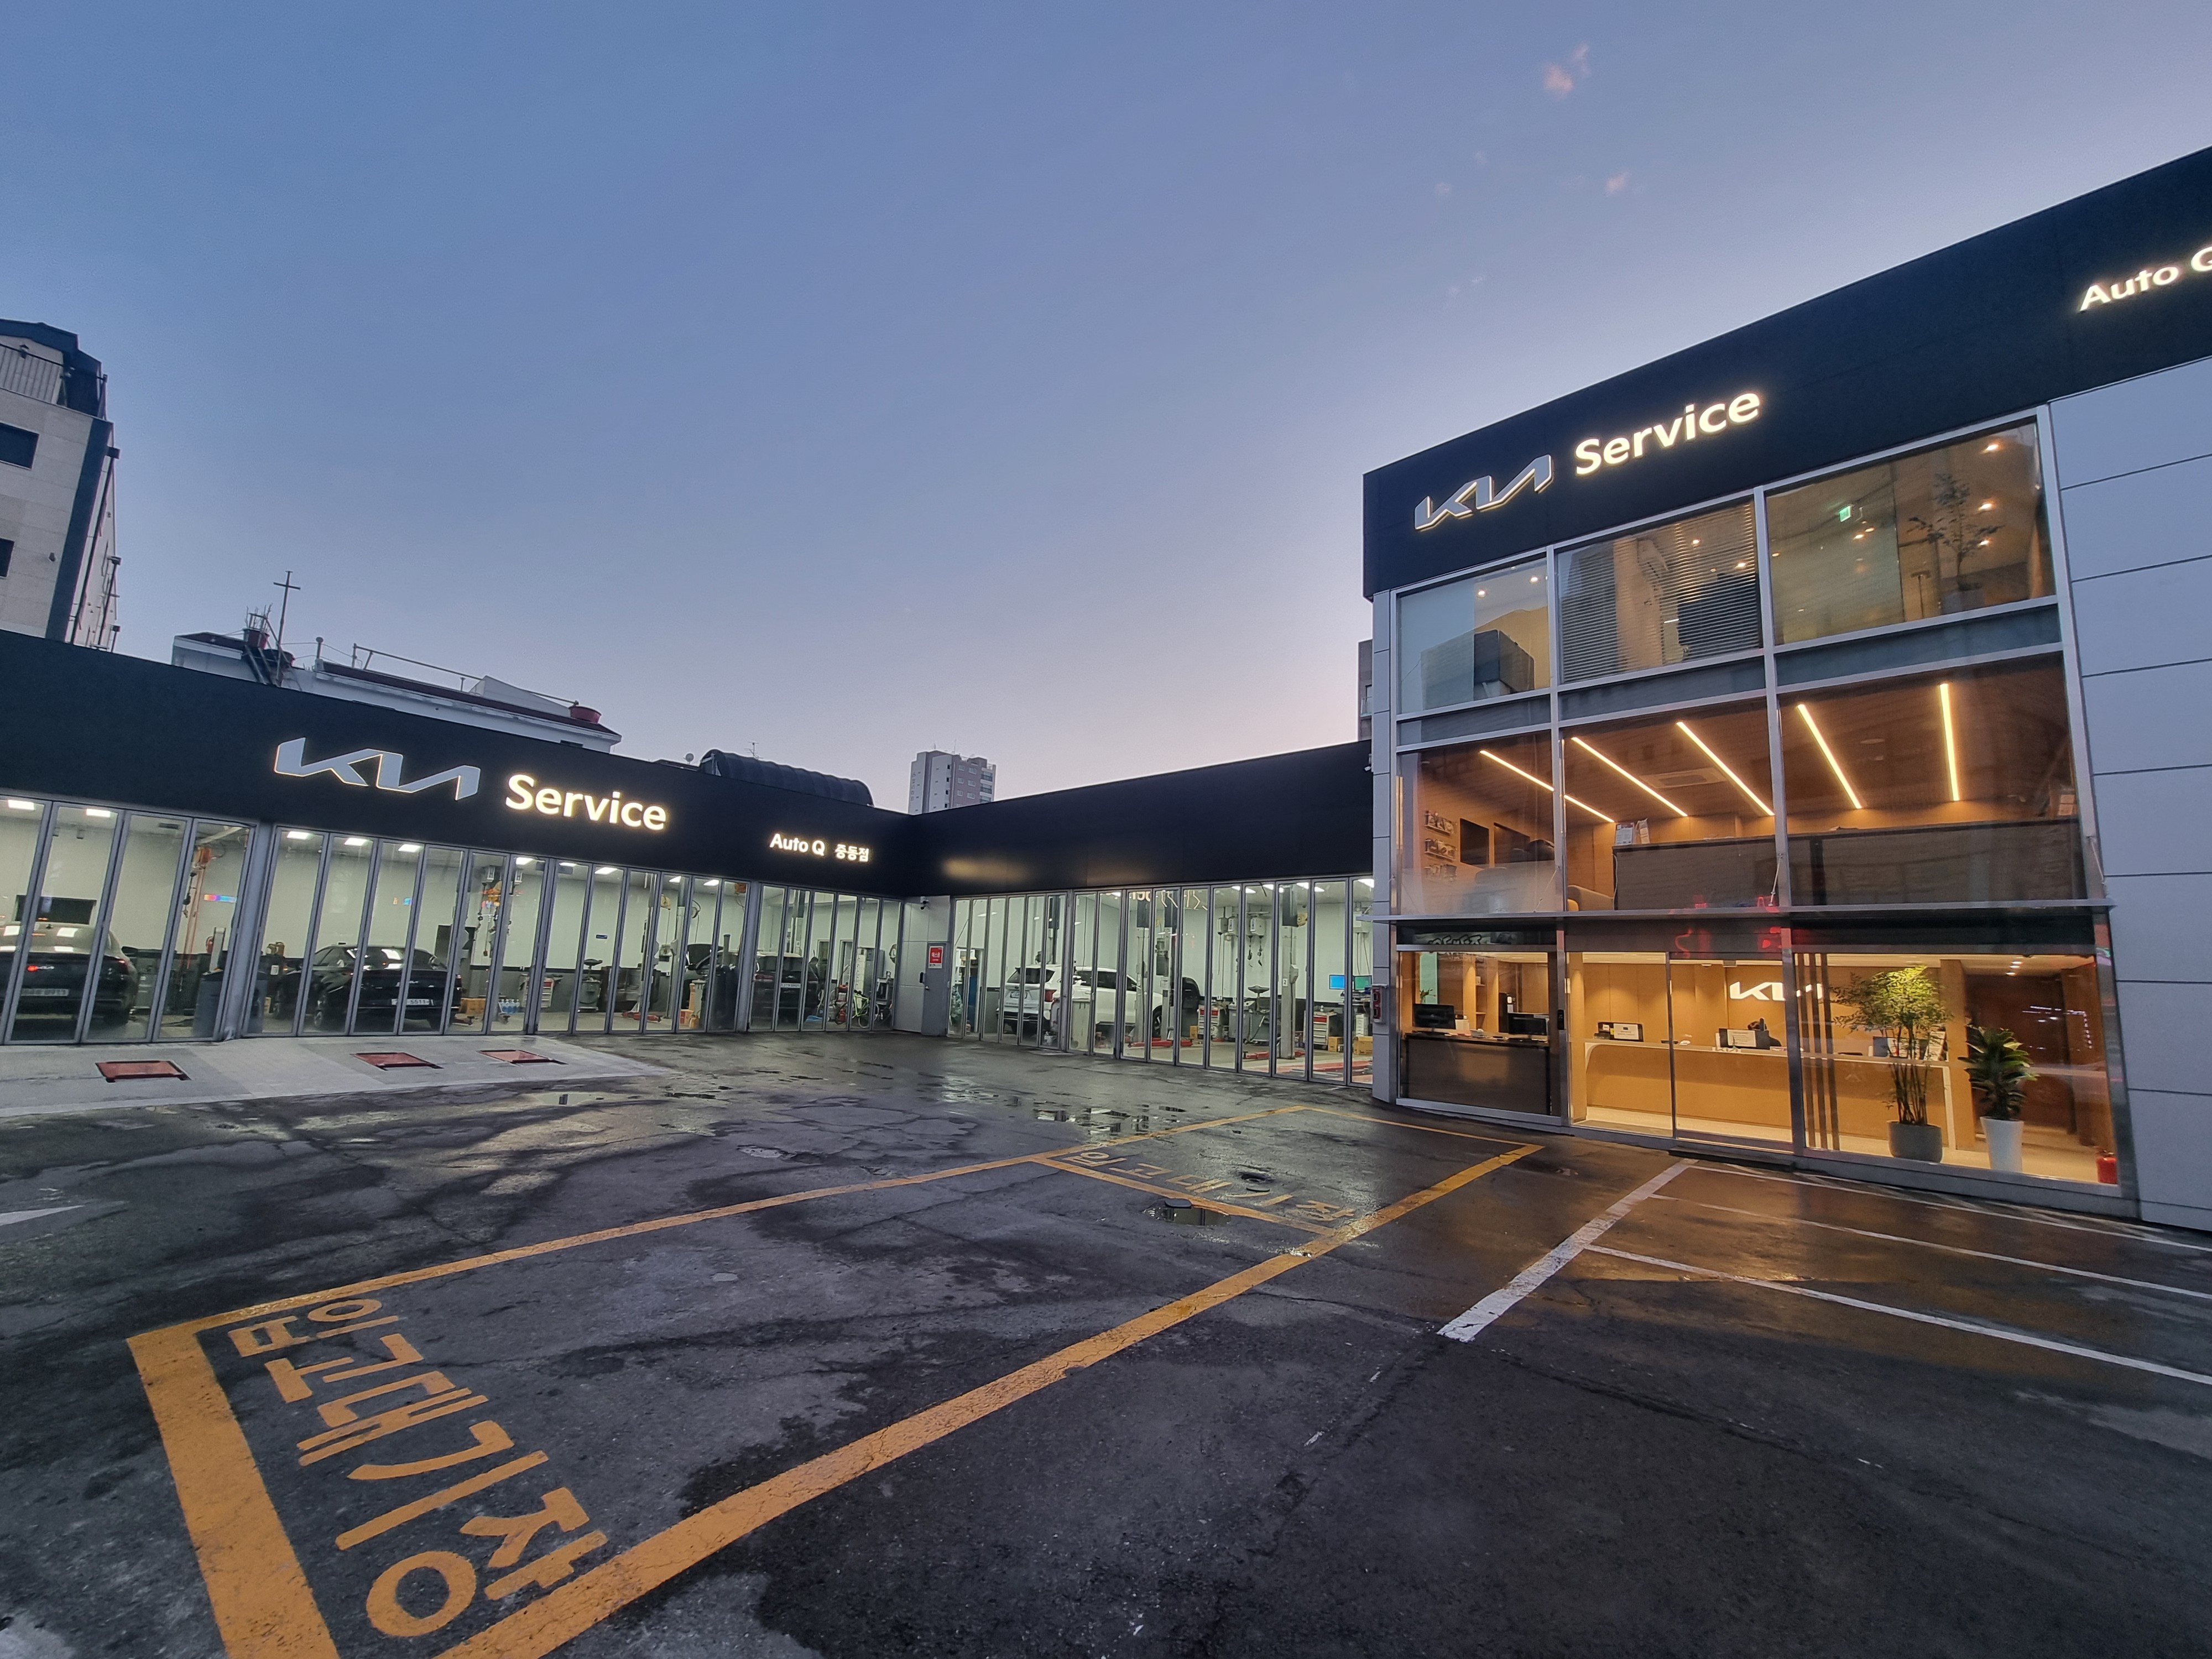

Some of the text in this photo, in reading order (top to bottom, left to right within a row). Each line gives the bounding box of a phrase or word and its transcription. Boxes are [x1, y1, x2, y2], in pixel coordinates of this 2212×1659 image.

[2080, 267, 2179, 311] Auto
[1575, 392, 1761, 476] Service
[505, 774, 666, 831] Service
[770, 833, 869, 862] Auto Q 중동점
[227, 1299, 608, 1637] 입고대기장
